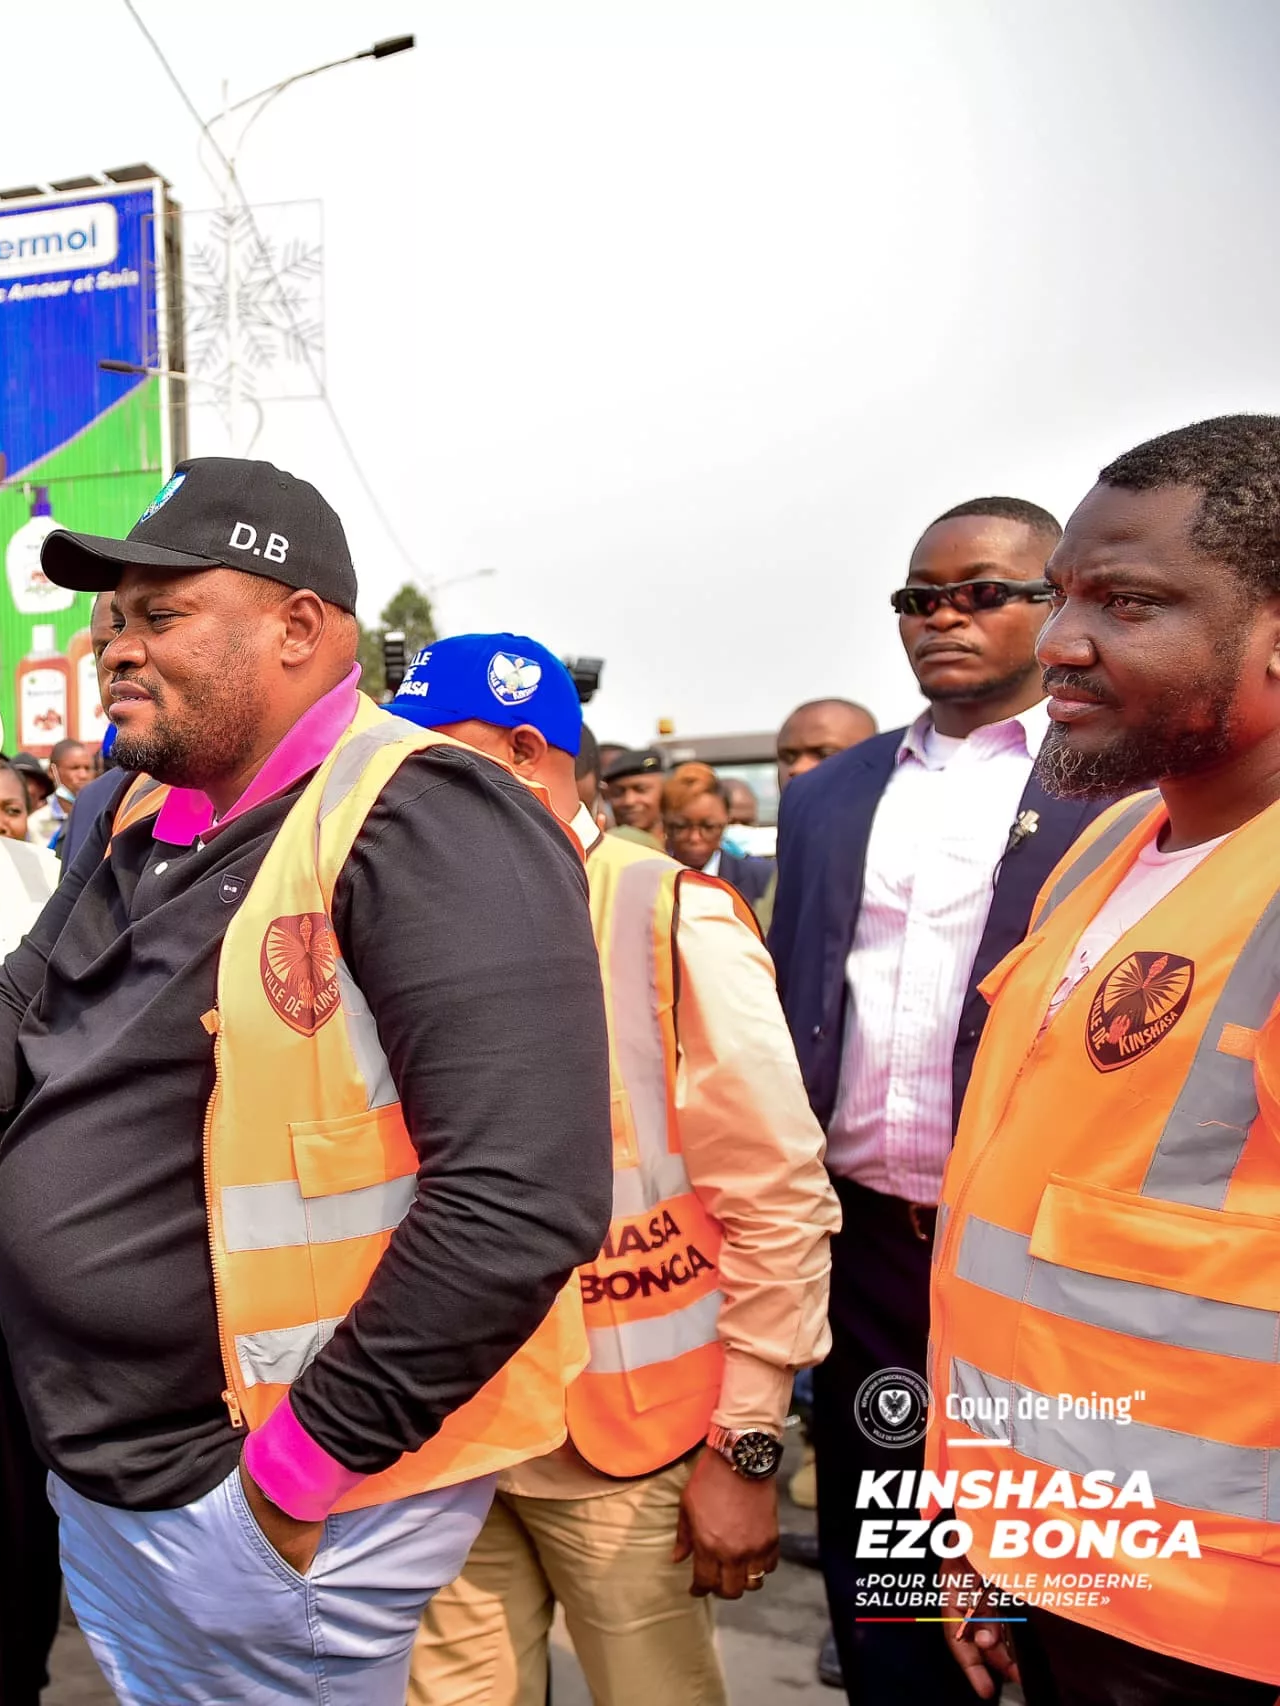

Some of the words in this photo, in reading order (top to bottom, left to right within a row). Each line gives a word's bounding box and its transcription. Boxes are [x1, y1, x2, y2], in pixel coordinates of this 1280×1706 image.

[228, 521, 290, 564] D.B
[264, 968, 286, 1004] VILLE
[284, 995, 305, 1019] DE
[1119, 1011, 1179, 1057] KINSHASA
[580, 1244, 716, 1304] BONGA
